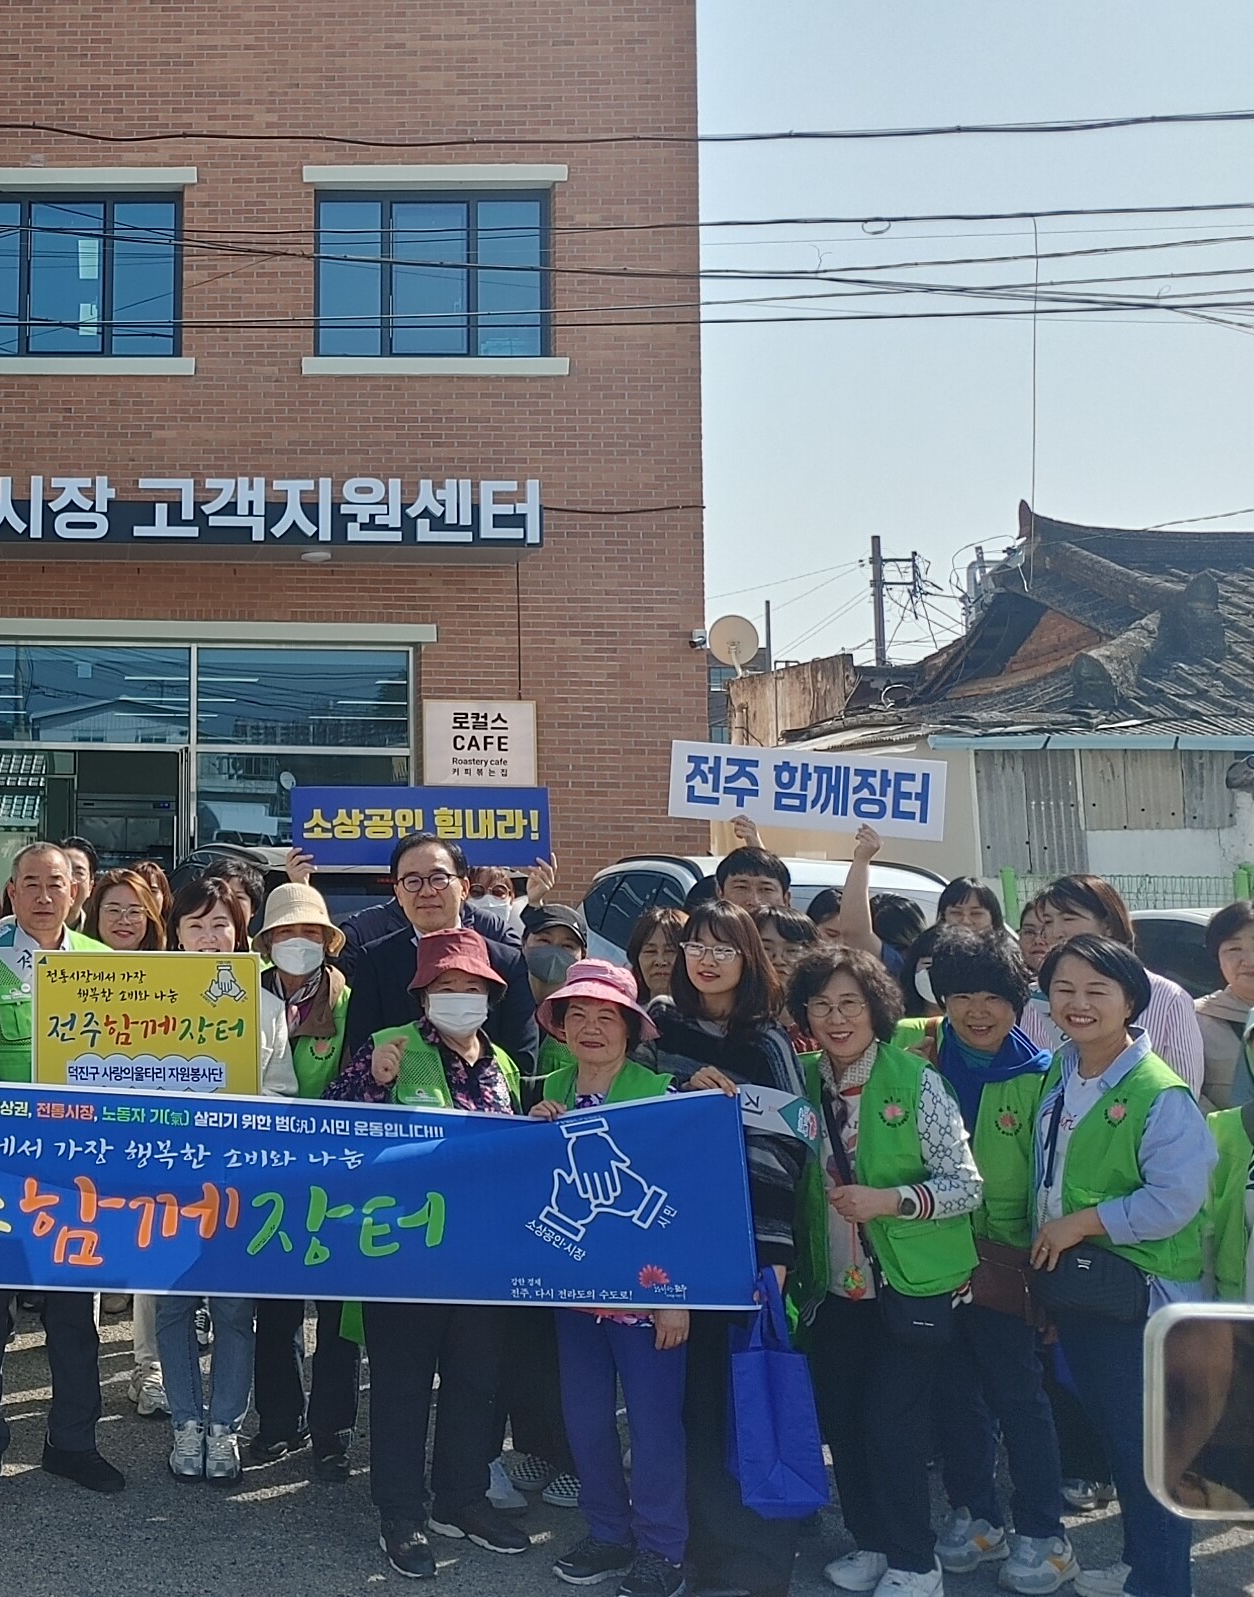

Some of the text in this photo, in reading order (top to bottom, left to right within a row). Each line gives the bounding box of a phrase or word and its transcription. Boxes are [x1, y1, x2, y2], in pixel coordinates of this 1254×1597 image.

[133, 475, 542, 548] 고객지원센터
[452, 712, 509, 730] 로컬스
[452, 735, 509, 752] CAFE
[452, 757, 508, 767] Roastery cafe
[685, 754, 932, 824] 전주 함께장터
[302, 807, 540, 841] 소상공인 힘내라!
[46, 969, 147, 984] 전통시장에서 가장
[77, 988, 179, 1003] 행복한 소비와 나눔
[68, 1065, 224, 1083] 덕진구 사랑의울타리 자원봉사단
[36, 1102, 98, 1122] 전통시장,
[101, 1106, 146, 1124] 노동자
[194, 1111, 238, 1129] 살리기
[241, 1113, 272, 1132] 위한
[320, 1116, 350, 1136] 시민
[353, 1119, 445, 1140] 운동입니다!!!
[53, 1135, 114, 1165] 가장
[124, 1139, 212, 1170] 행복한
[224, 1146, 297, 1170] 소비와
[308, 1147, 365, 1171] 나눔
[657, 1205, 678, 1229] 시민
[511, 1277, 526, 1286] 강한
[535, 1289, 554, 1299] 다시
[558, 1289, 596, 1300] 전라도의
[599, 1289, 633, 1300] 수도로!
